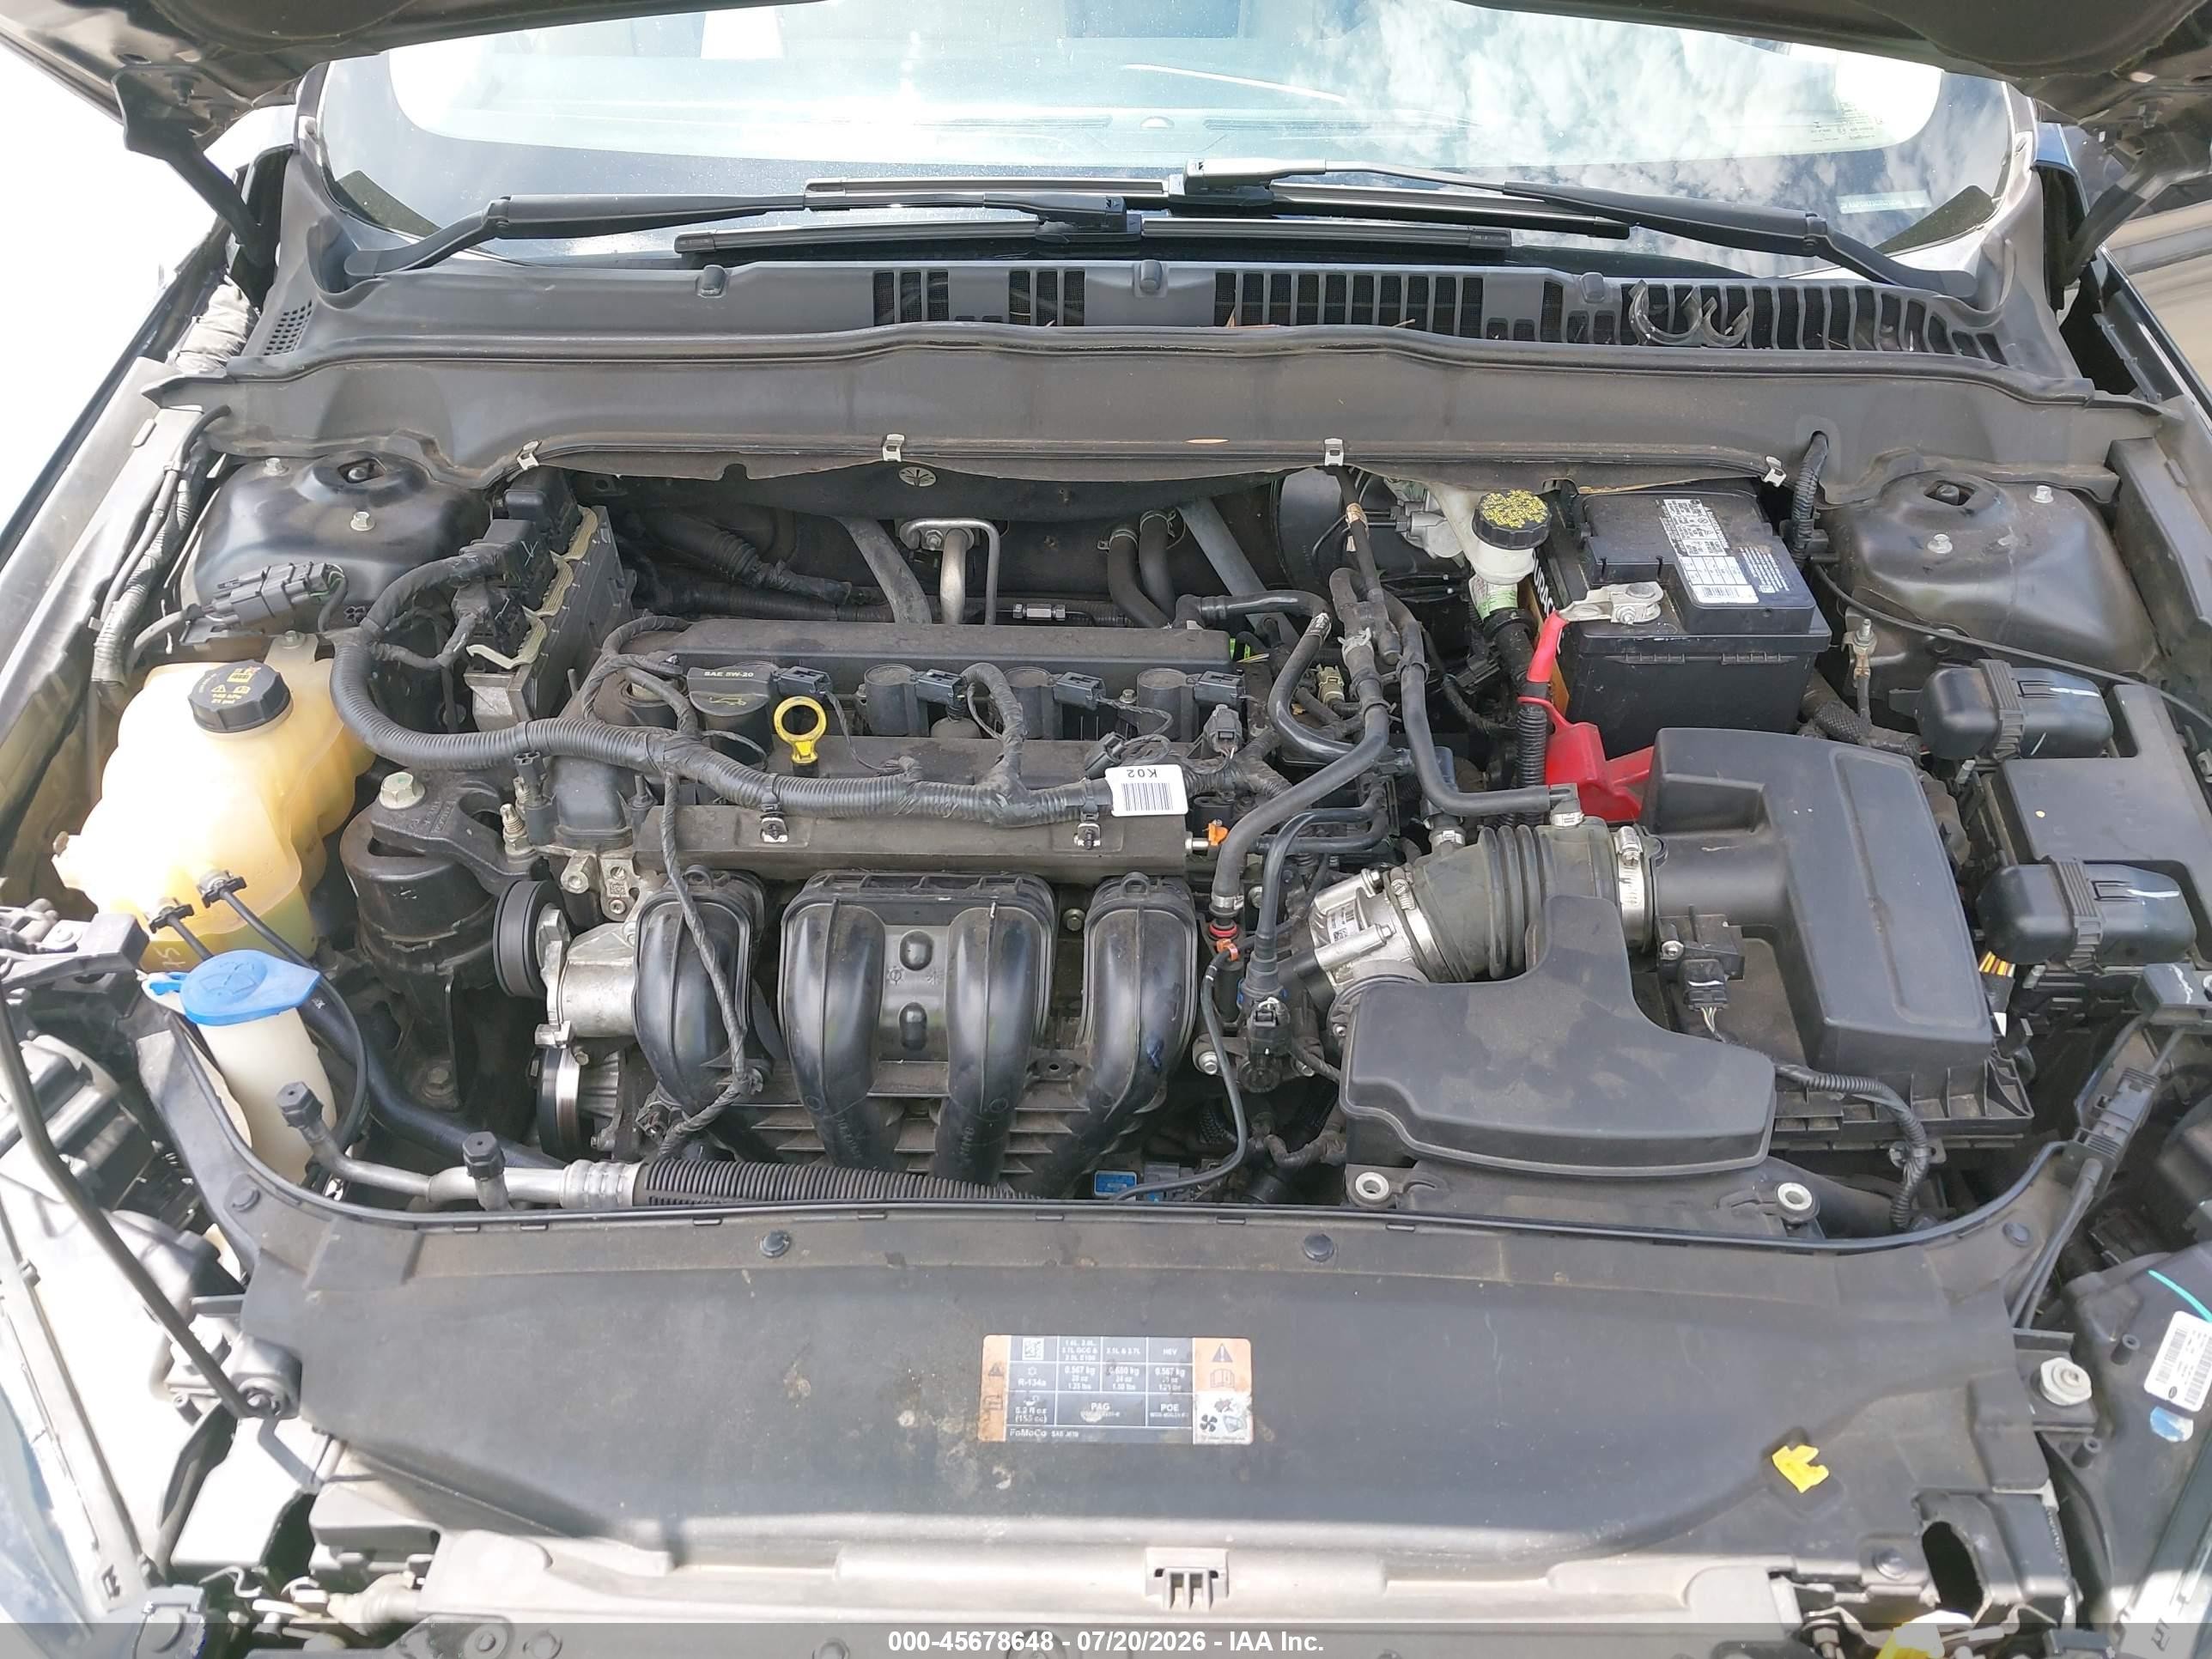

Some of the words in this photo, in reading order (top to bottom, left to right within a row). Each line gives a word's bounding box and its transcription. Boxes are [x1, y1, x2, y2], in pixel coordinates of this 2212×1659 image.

[1127, 769, 1158, 778] K02
[1085, 1366, 1096, 1376] kg
[1129, 1367, 1139, 1376] kg
[1176, 1367, 1185, 1376] kg
[1018, 1378, 1047, 1387] R-134a
[1091, 1402, 1110, 1411] PAG
[1160, 1403, 1180, 1412] POE
[1010, 1428, 1047, 1437] FoMoCo
